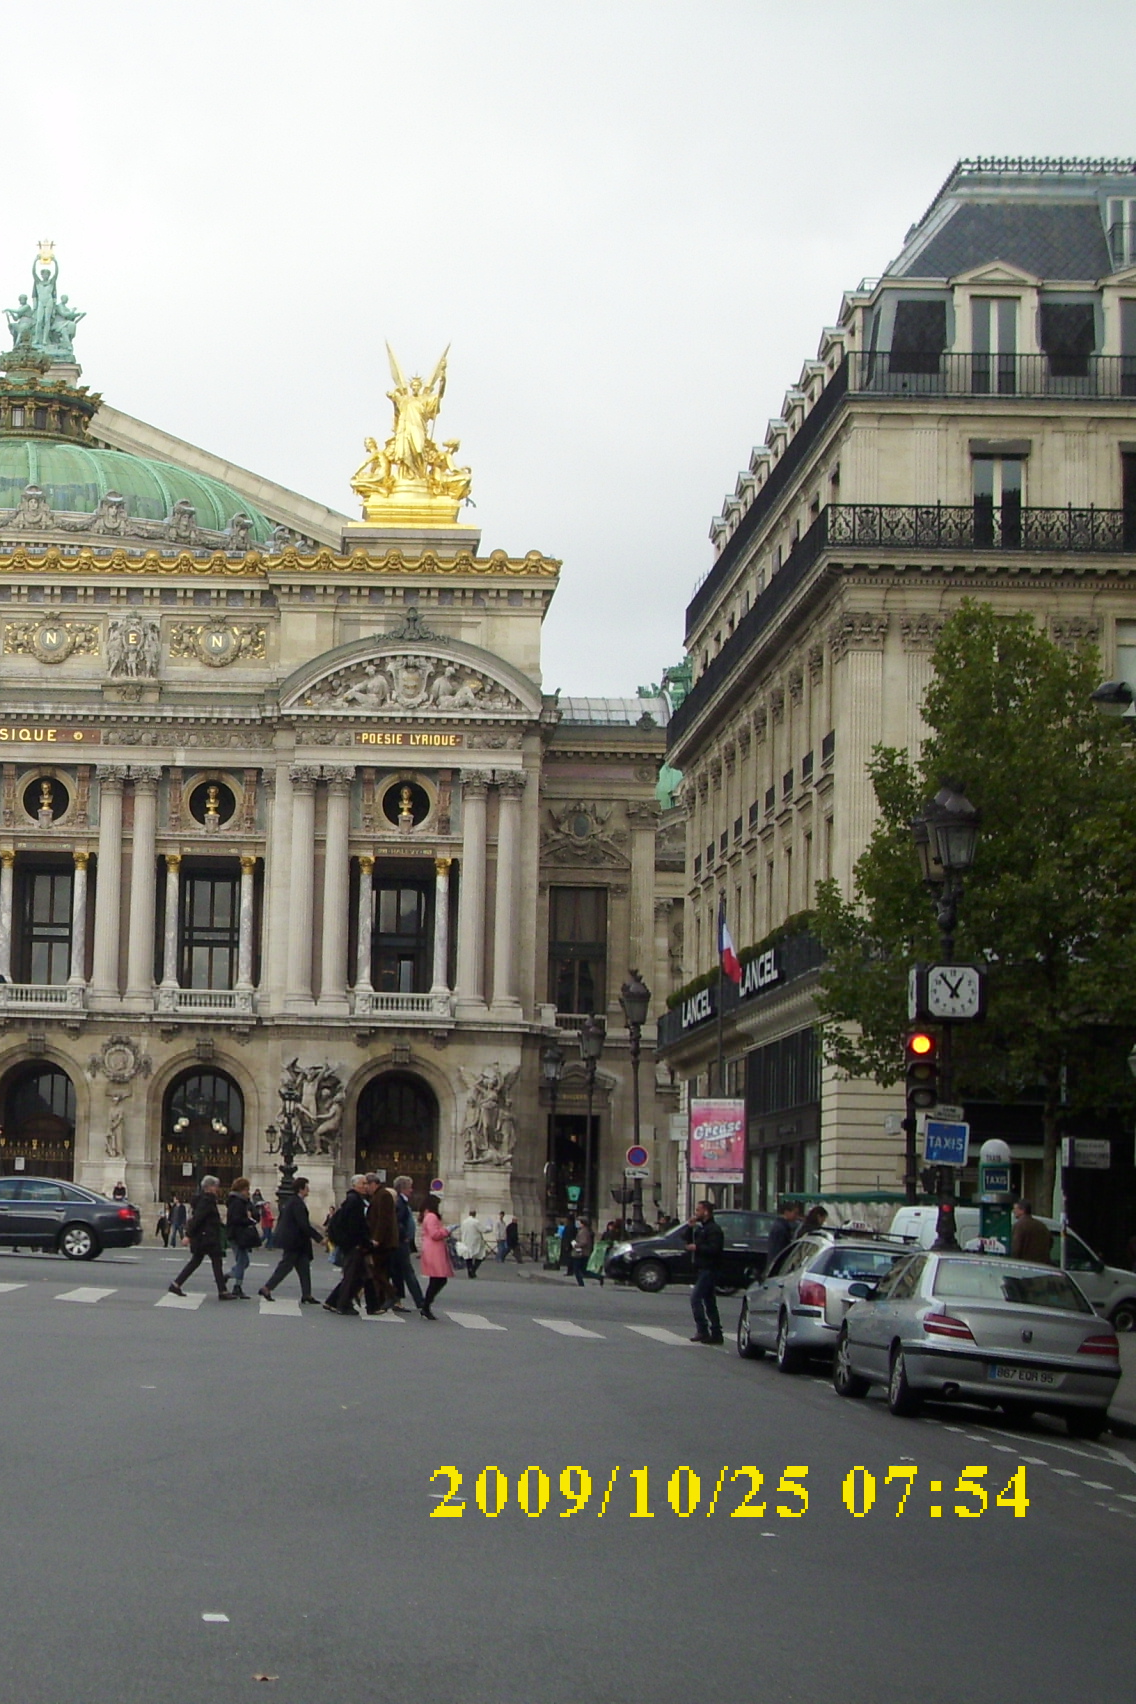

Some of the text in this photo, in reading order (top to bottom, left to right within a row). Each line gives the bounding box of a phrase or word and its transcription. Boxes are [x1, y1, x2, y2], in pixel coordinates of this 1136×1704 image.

[46, 632, 57, 644] N
[129, 633, 137, 644] E
[212, 635, 222, 647] N
[362, 733, 456, 746] POESIE LYRIQUE
[739, 948, 778, 998] LANCEL
[682, 988, 712, 1028] LANCEL
[928, 1135, 964, 1151] TAXIS
[985, 1174, 1007, 1185] TAXIS
